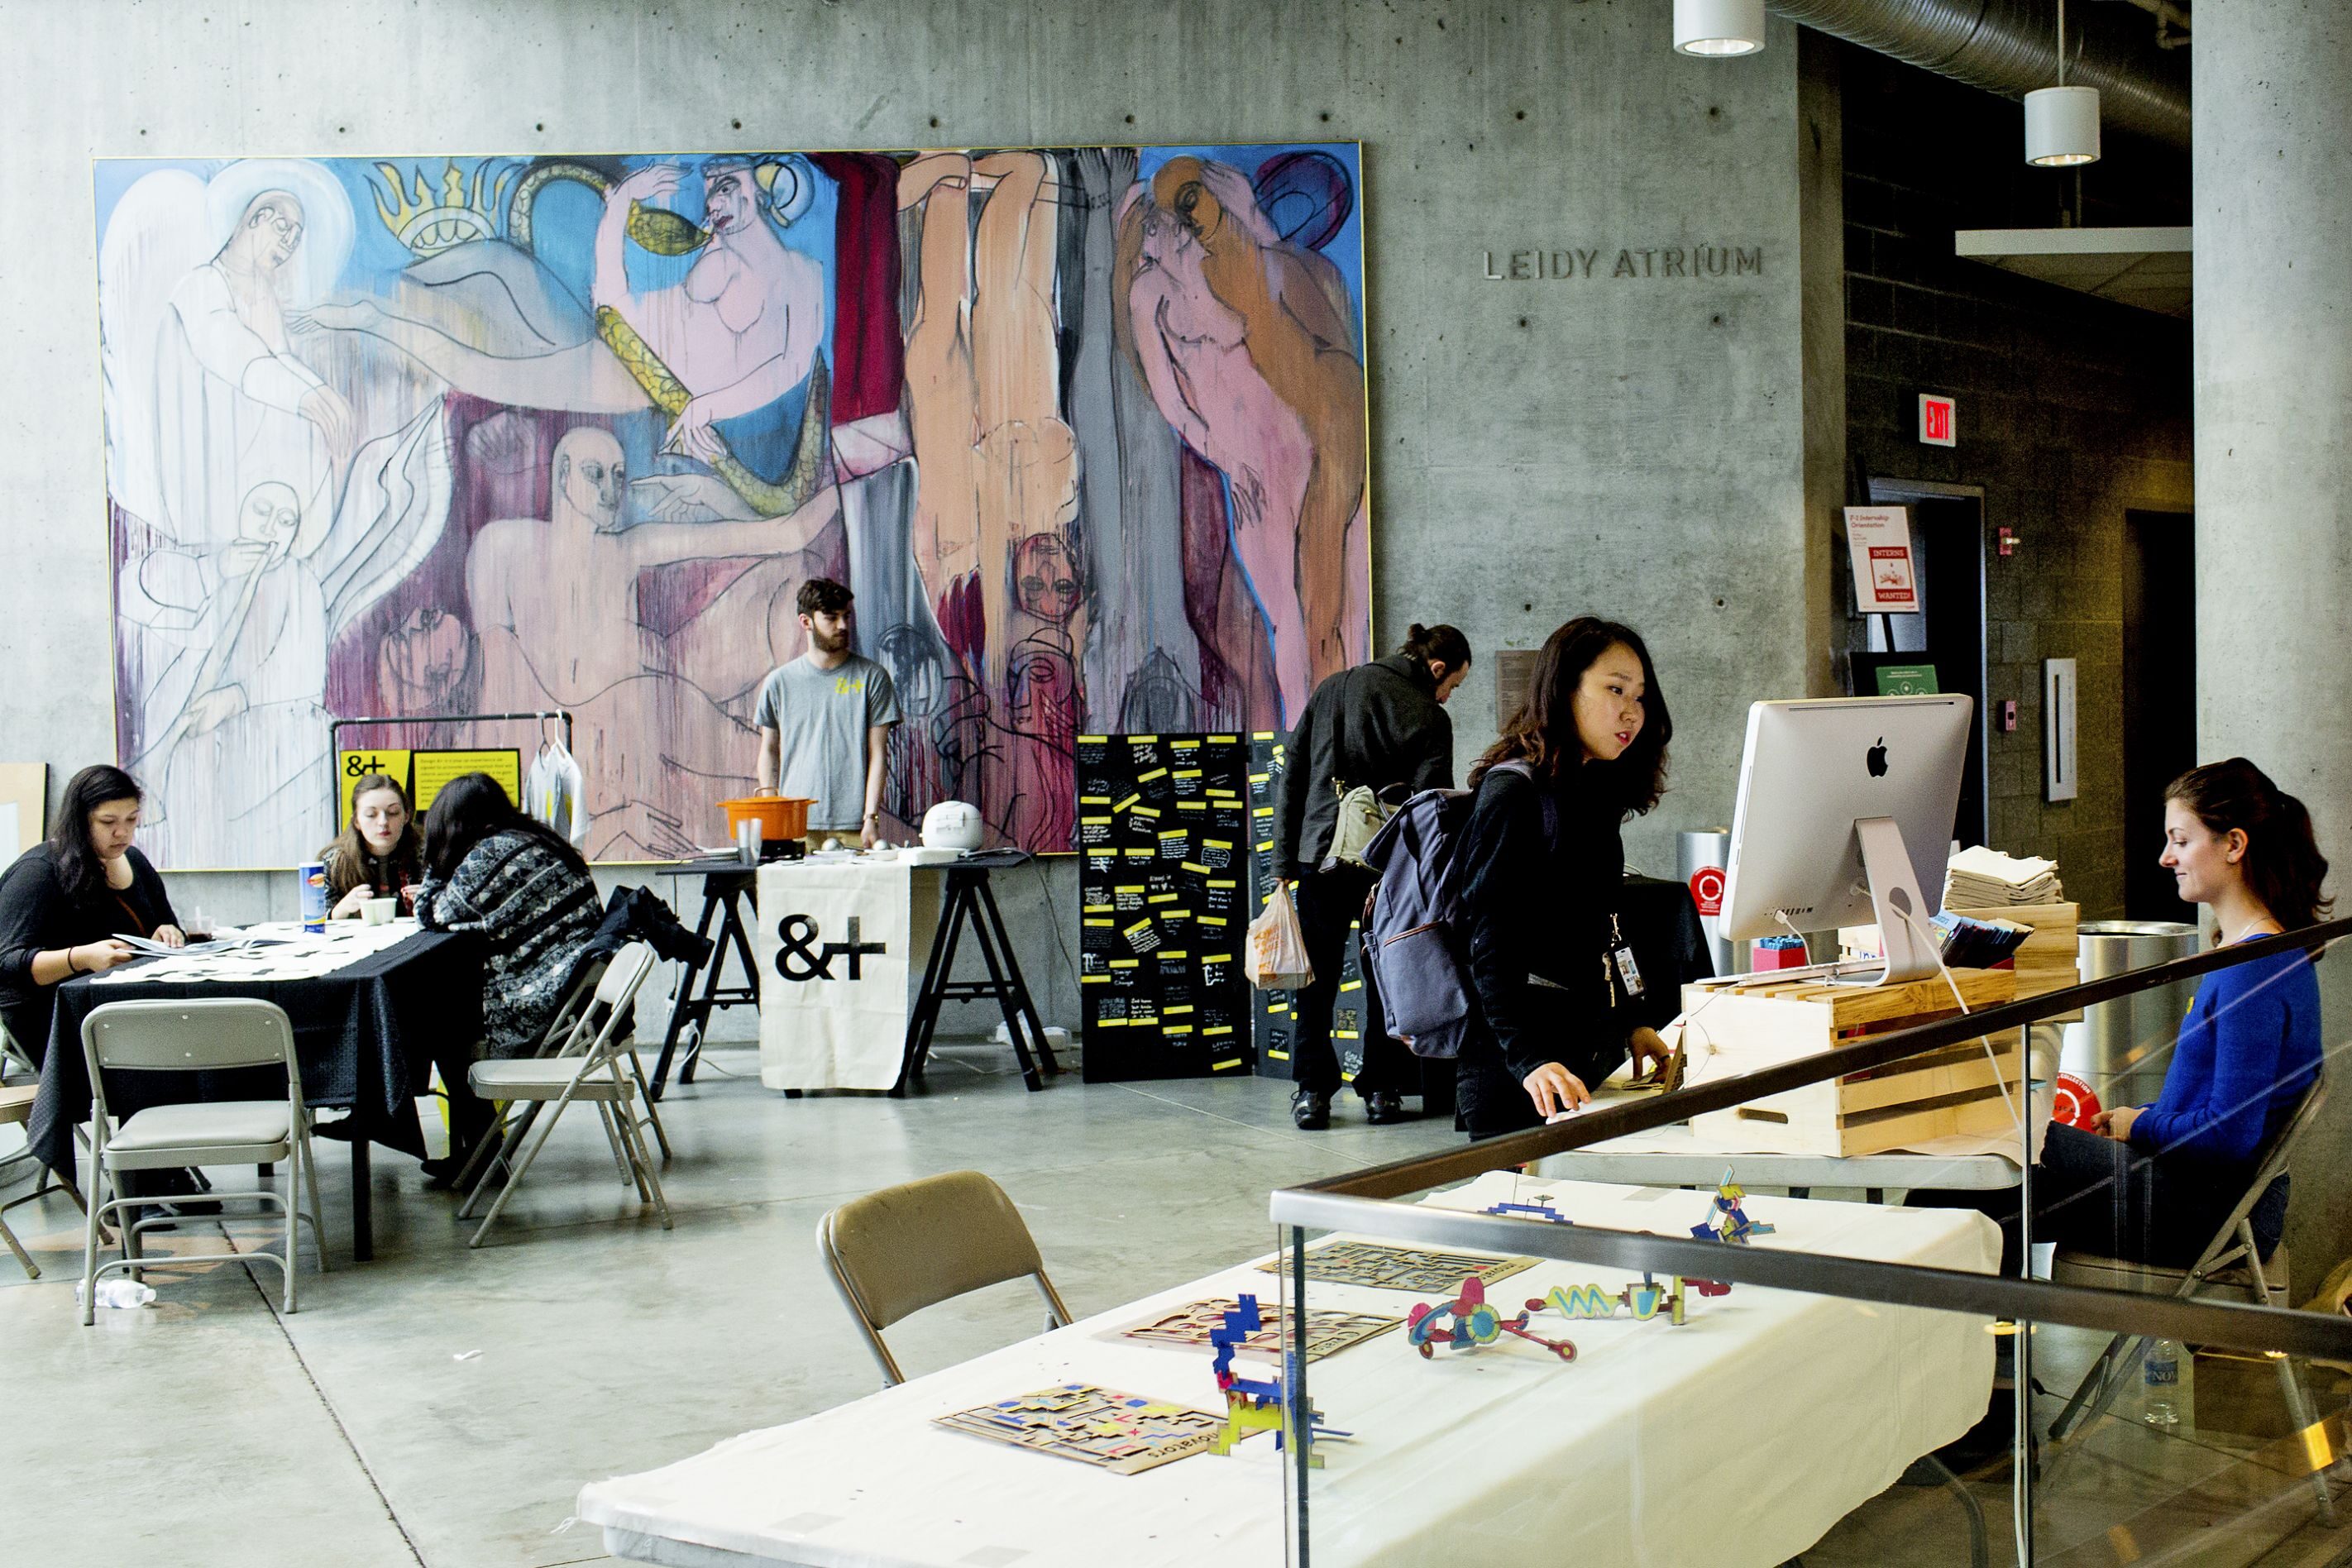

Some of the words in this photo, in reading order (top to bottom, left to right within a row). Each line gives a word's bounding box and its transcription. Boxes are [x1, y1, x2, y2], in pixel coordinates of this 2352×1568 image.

[1483, 247, 1599, 280] LEIDY
[1613, 246, 1763, 279] ATRIUM
[1925, 400, 1950, 440] EXIT
[1859, 514, 1890, 523] Internship
[834, 677, 864, 694] &+
[346, 755, 386, 777] &+
[775, 913, 887, 982] &+
[1146, 1431, 1218, 1458] novators
